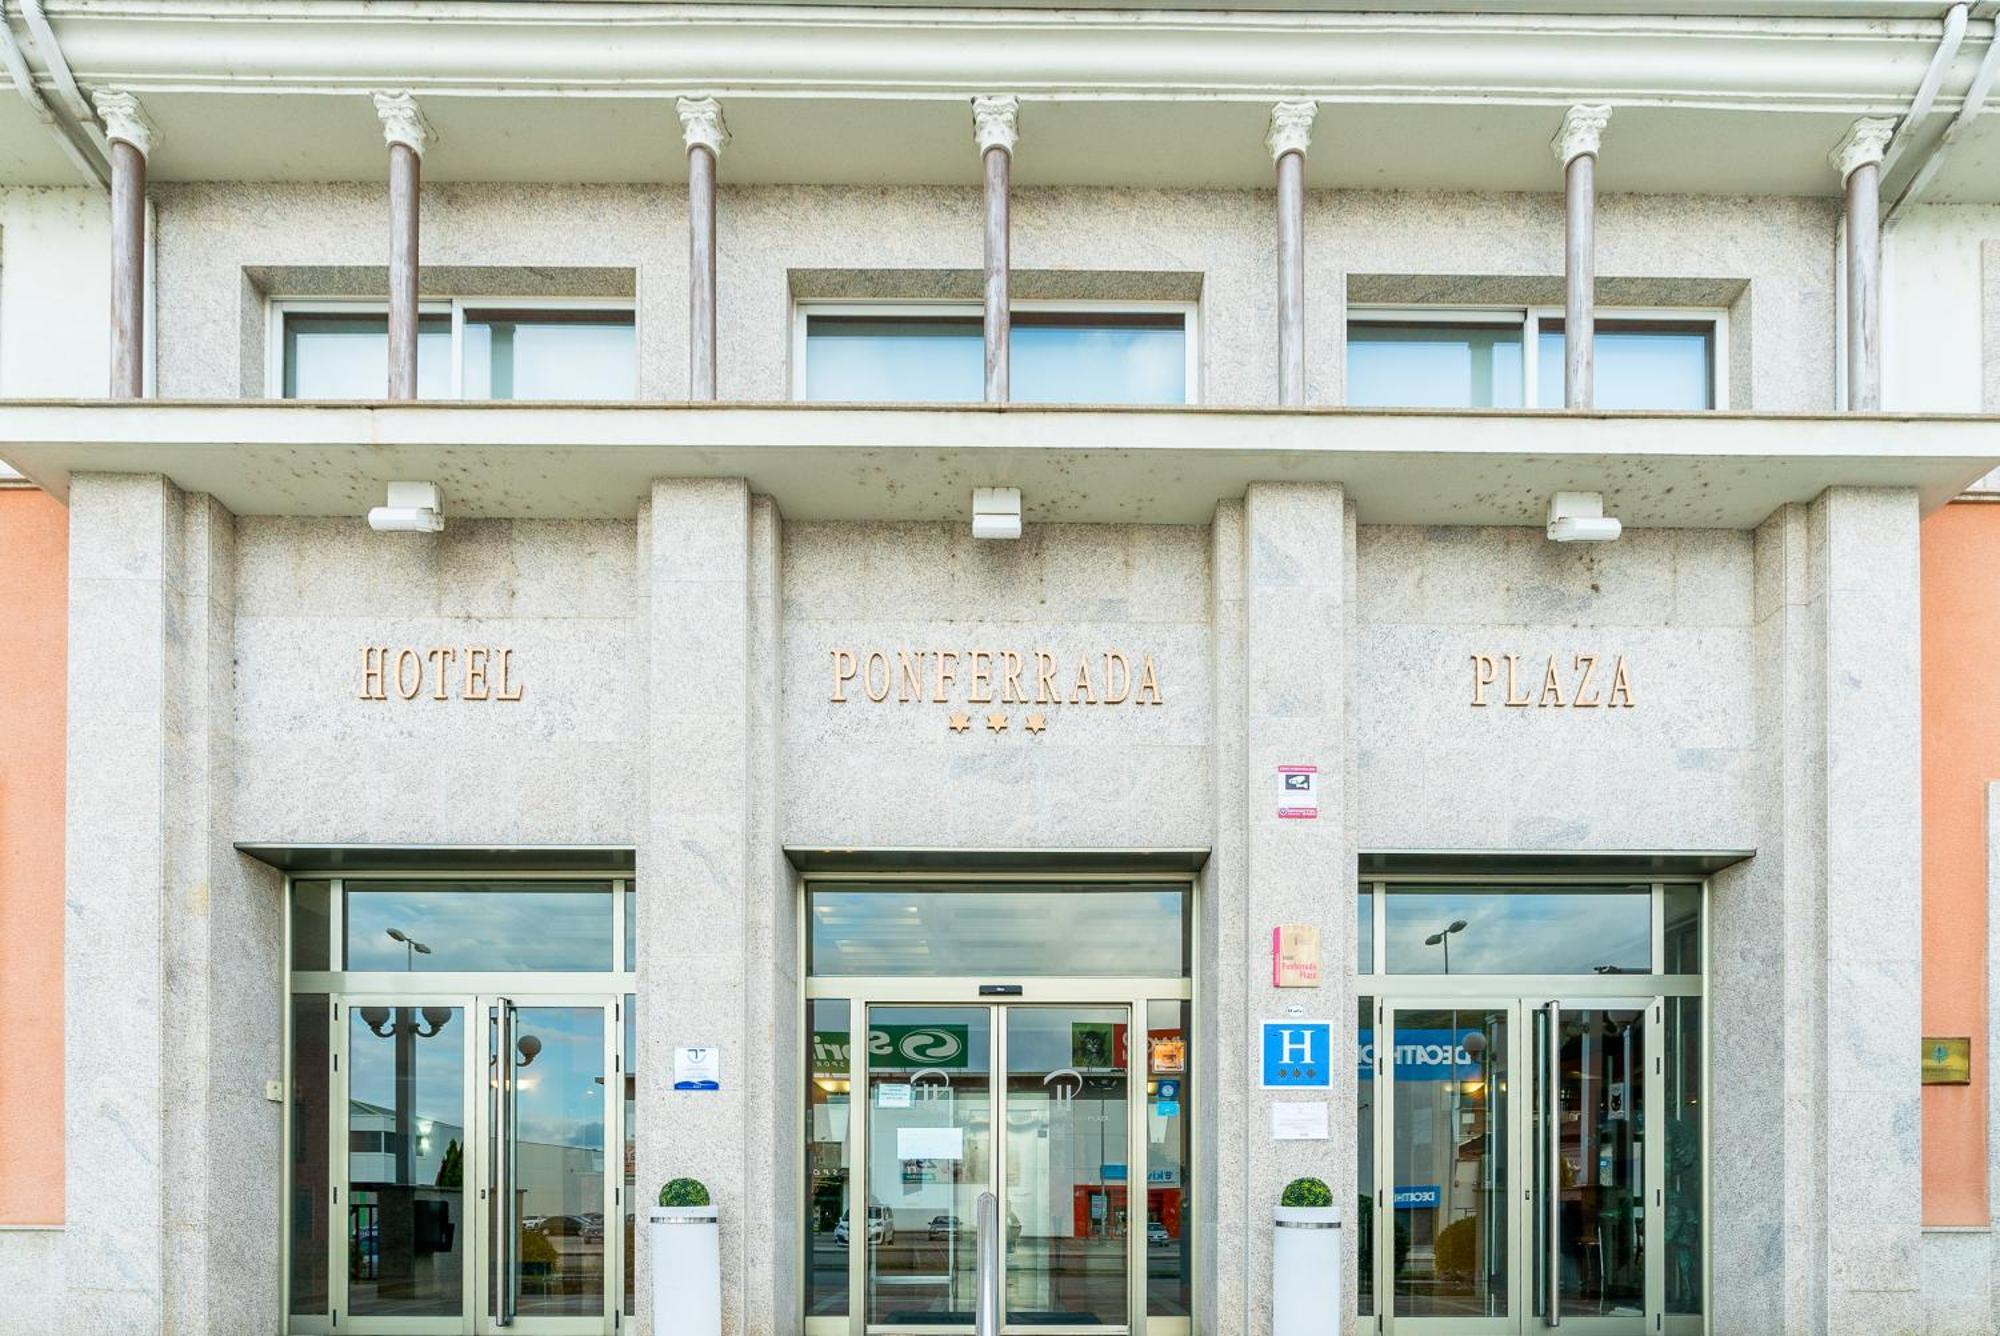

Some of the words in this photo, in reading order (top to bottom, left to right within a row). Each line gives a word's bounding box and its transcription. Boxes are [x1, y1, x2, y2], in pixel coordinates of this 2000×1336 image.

[359, 647, 523, 701] HOTEL
[830, 650, 1163, 705] PONFERRADA
[1470, 654, 1635, 708] PLAZA
[1278, 1030, 1316, 1064] H
